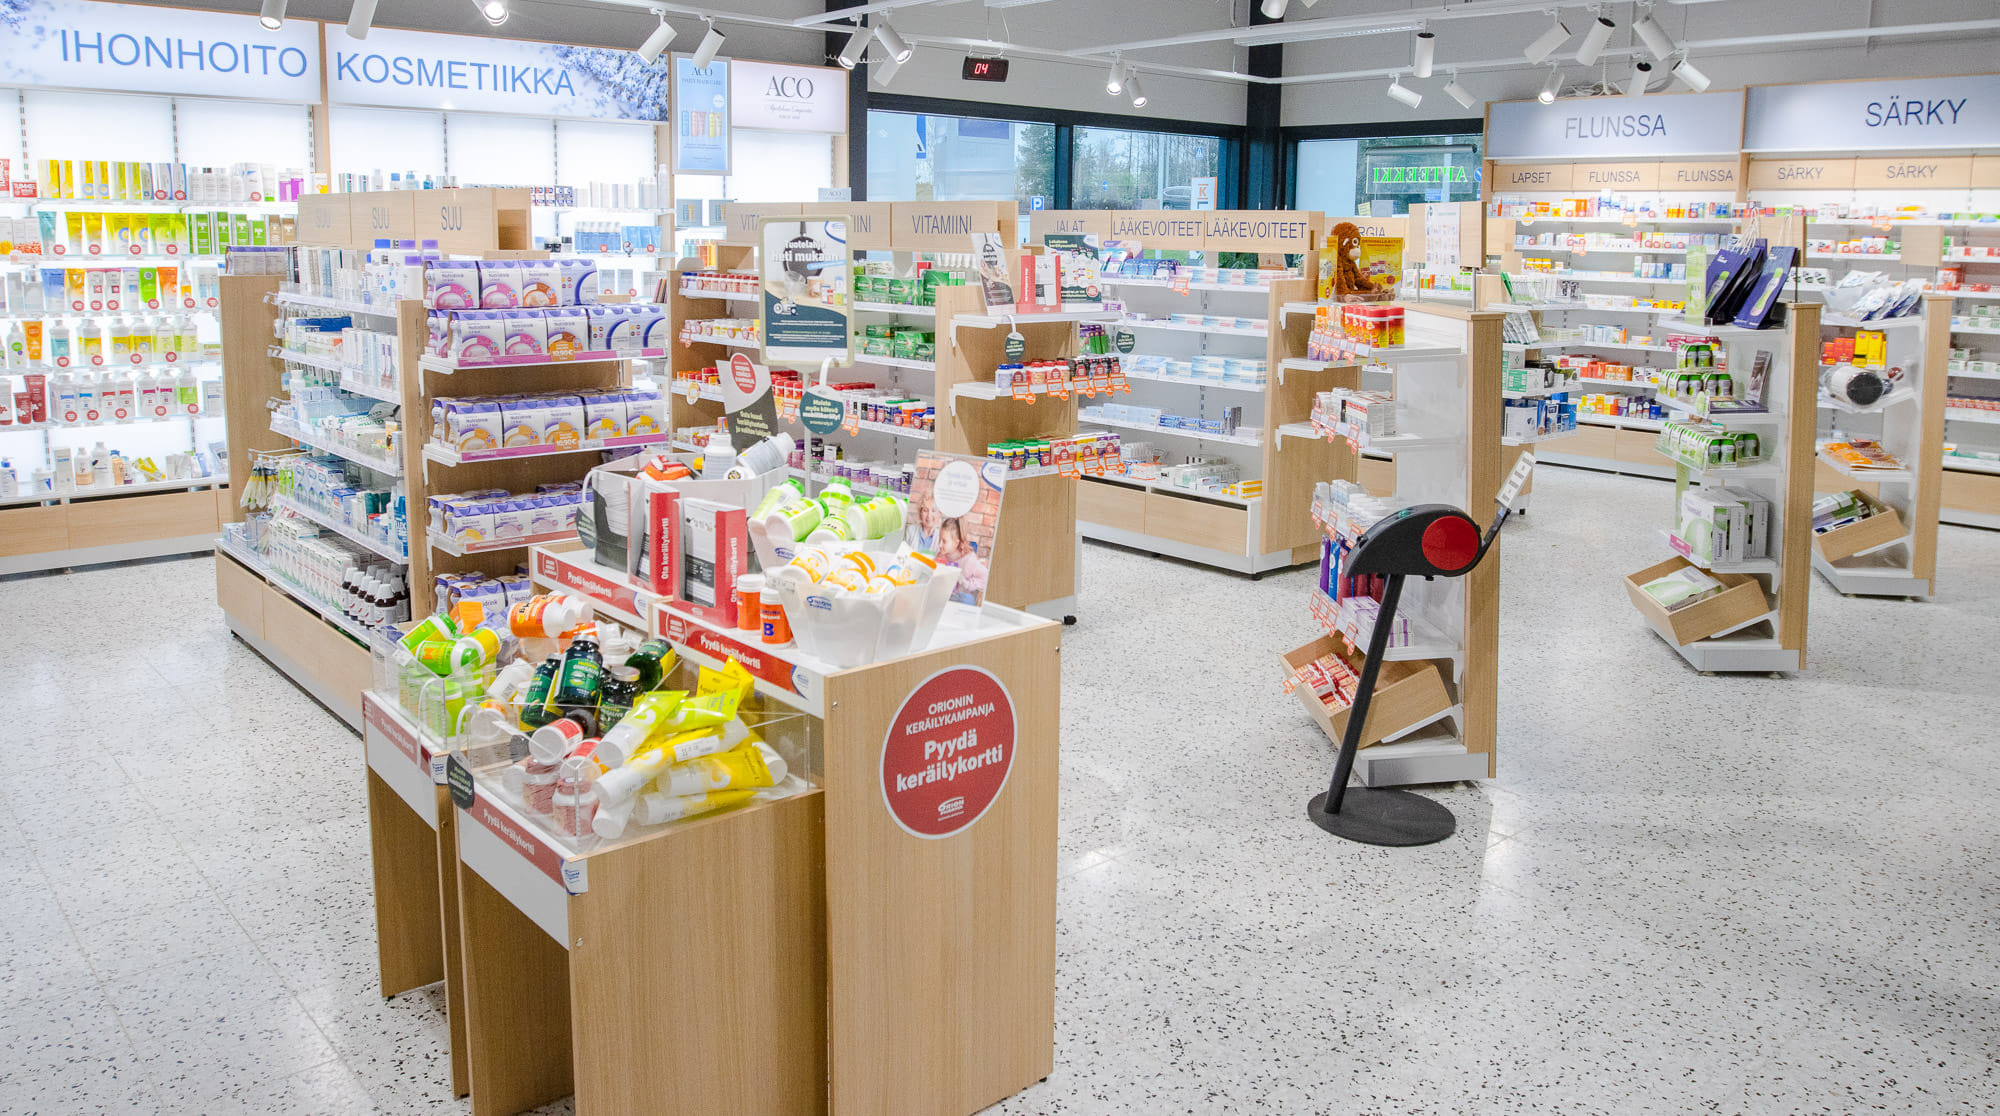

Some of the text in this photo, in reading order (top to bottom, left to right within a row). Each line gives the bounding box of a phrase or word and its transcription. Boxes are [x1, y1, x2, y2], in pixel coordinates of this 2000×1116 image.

[60, 28, 308, 77] IHONHOITO
[336, 51, 576, 97] KOSMETIIKKA
[974, 62, 989, 75] 04
[764, 75, 815, 99] ACO
[1865, 96, 1967, 128] SÄRKY
[1565, 113, 1667, 139] FLUNSSA
[1512, 171, 1552, 184] LAPSET
[1589, 170, 1641, 183] FLUNSSA
[1677, 169, 1734, 183] FLUNSSA
[1777, 164, 1824, 181] SÄRKY
[1887, 163, 1938, 180] SÄRKY
[1034, 198, 1042, 210] P
[315, 208, 332, 229] SUU
[371, 207, 390, 230] SUU
[441, 205, 463, 232] SUU
[911, 214, 972, 235] VITAMIINI
[1113, 216, 1203, 237] LÄÄKEVOITEET
[1206, 217, 1308, 240] LÄÄKEVOITEET
[661, 518, 670, 580] Ota keräilykortti
[567, 571, 582, 589] Pyydä
[763, 622, 774, 636] B
[701, 634, 720, 653] Pyydä
[928, 694, 974, 715] ORIONIN
[905, 702, 995, 736] KERÄILYKAMPANJA
[924, 729, 978, 760] Pyydä
[896, 744, 1003, 793] keräilykortti
[483, 808, 500, 829] Pyydä
